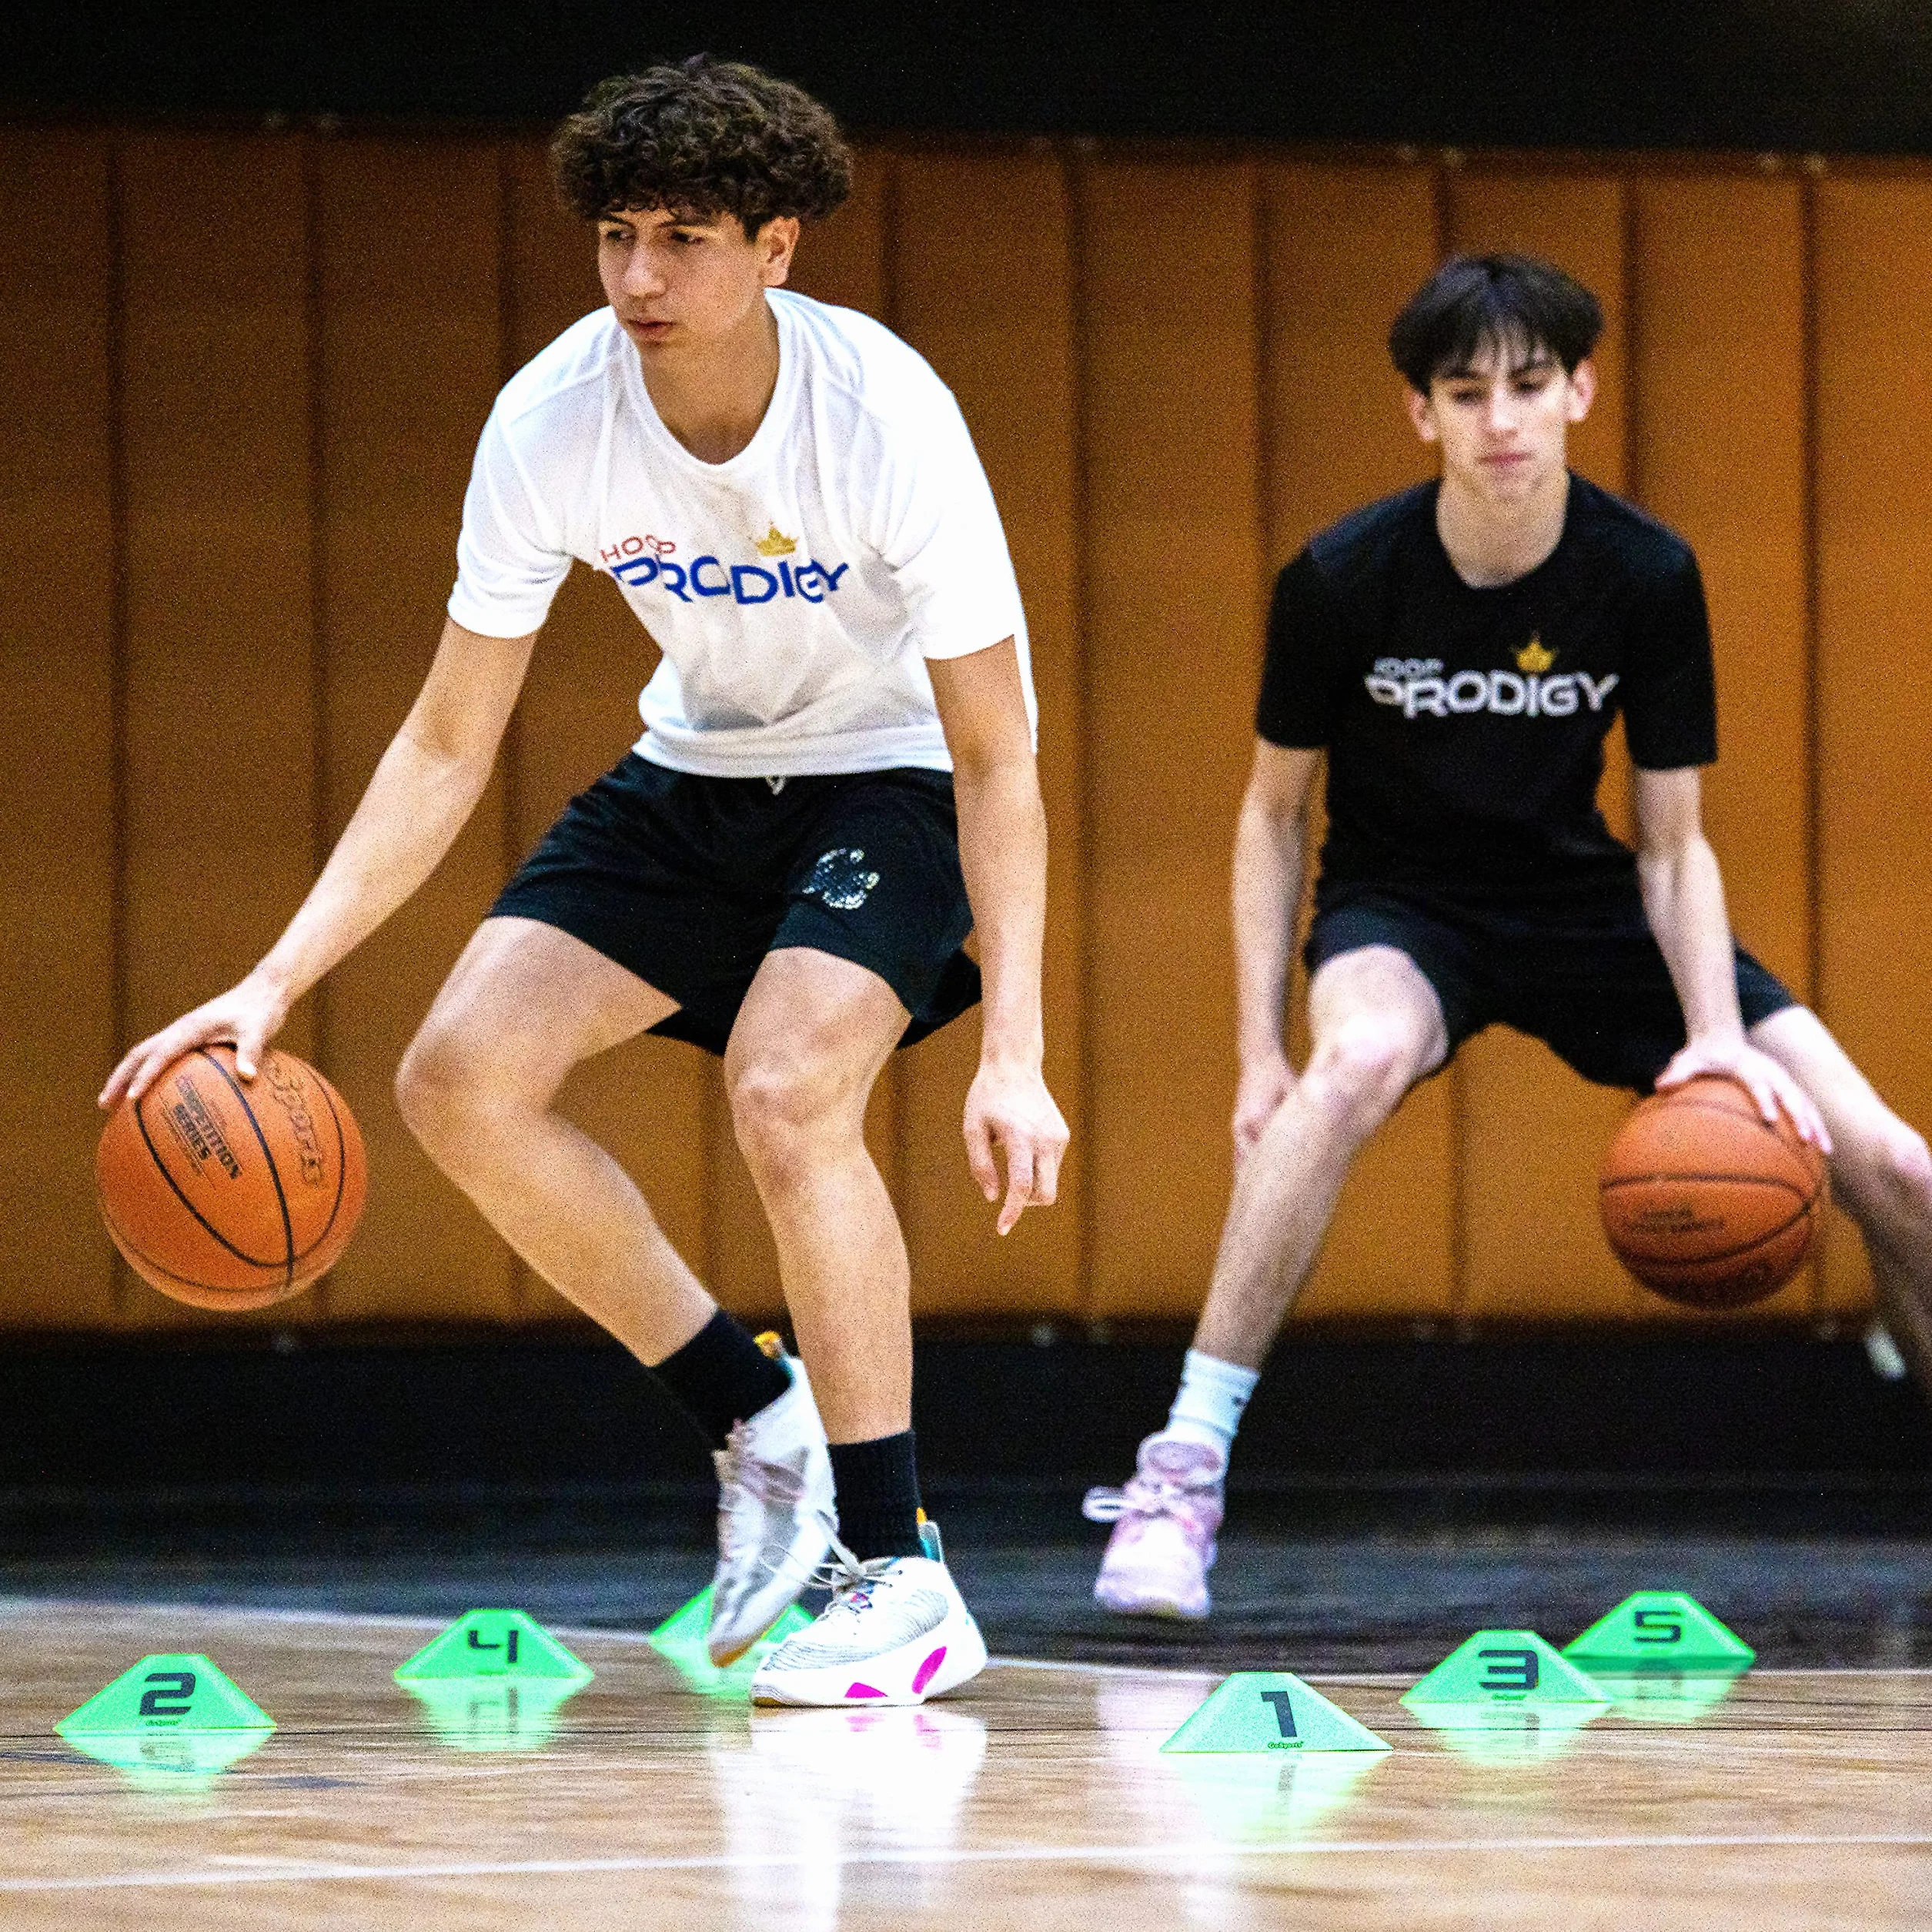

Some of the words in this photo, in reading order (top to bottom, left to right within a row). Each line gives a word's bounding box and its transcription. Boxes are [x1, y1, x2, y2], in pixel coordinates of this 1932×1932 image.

[1364, 669, 1619, 719] PRODIGY
[468, 1629, 519, 1663] 4
[1634, 1610, 1682, 1643] 5
[1479, 1650, 1539, 1690] 3
[139, 1672, 196, 1716] 2
[1260, 1690, 1298, 1738] 1
